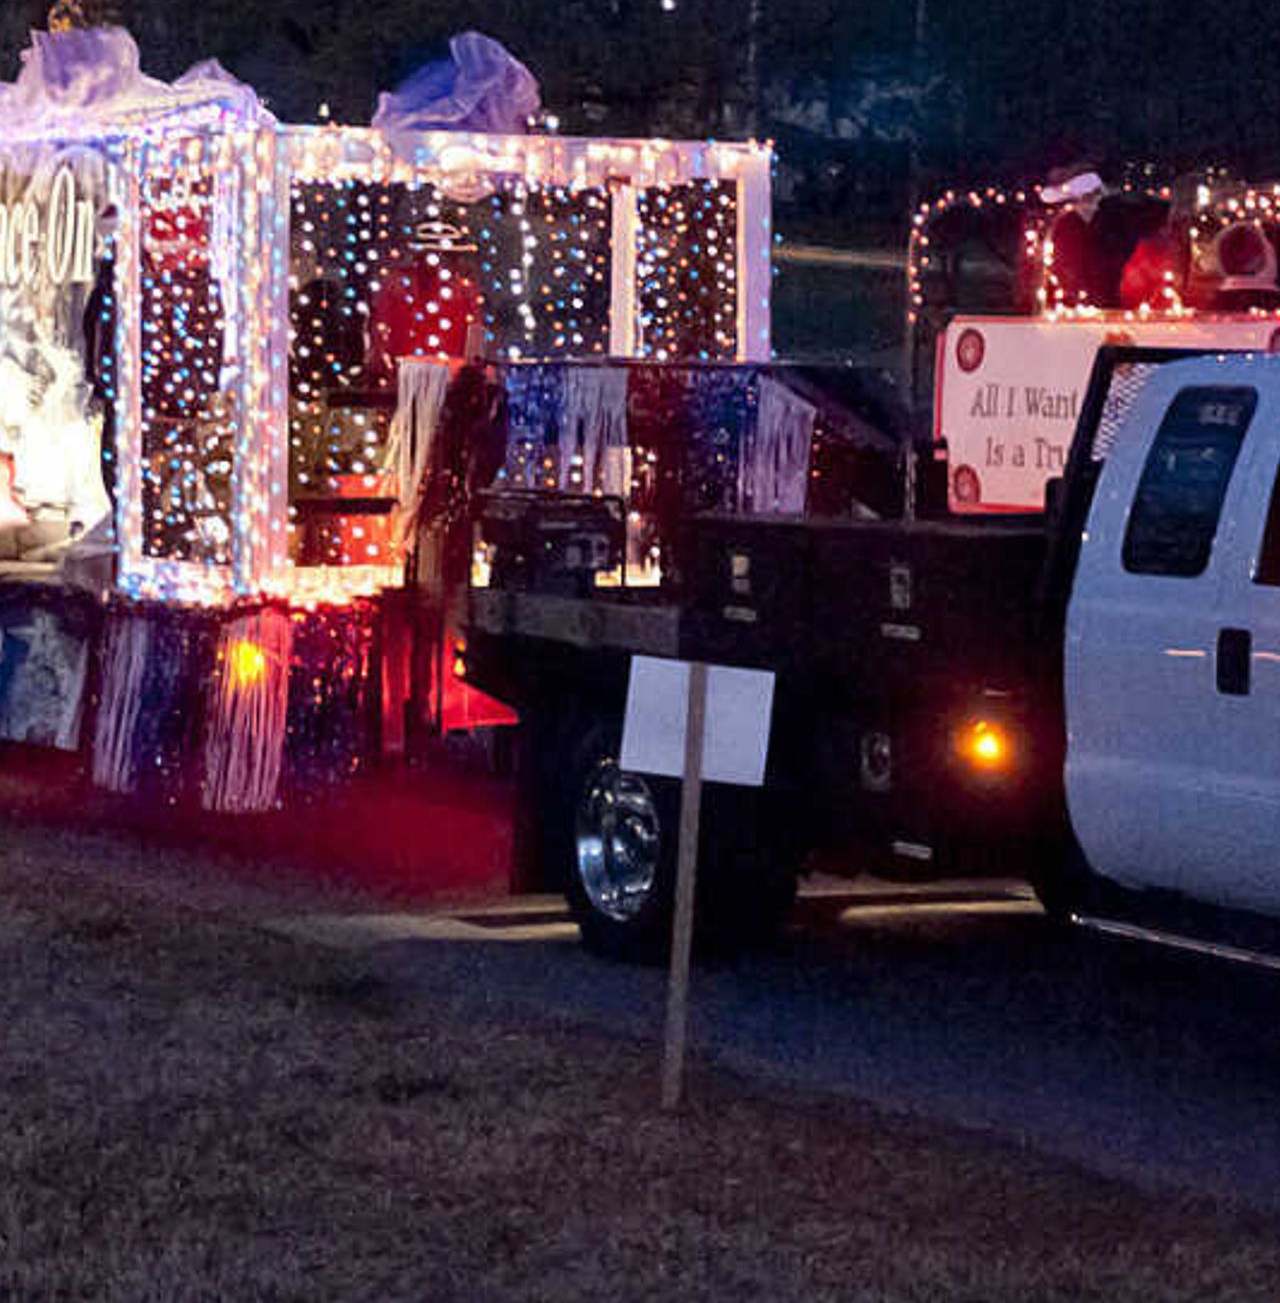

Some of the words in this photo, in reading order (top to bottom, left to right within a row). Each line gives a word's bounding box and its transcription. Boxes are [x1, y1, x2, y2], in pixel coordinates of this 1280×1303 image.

[971, 383, 999, 418] All
[1006, 386, 1016, 418] I
[1025, 385, 1078, 420] Want
[985, 436, 1004, 467] Is
[1012, 443, 1025, 468] a
